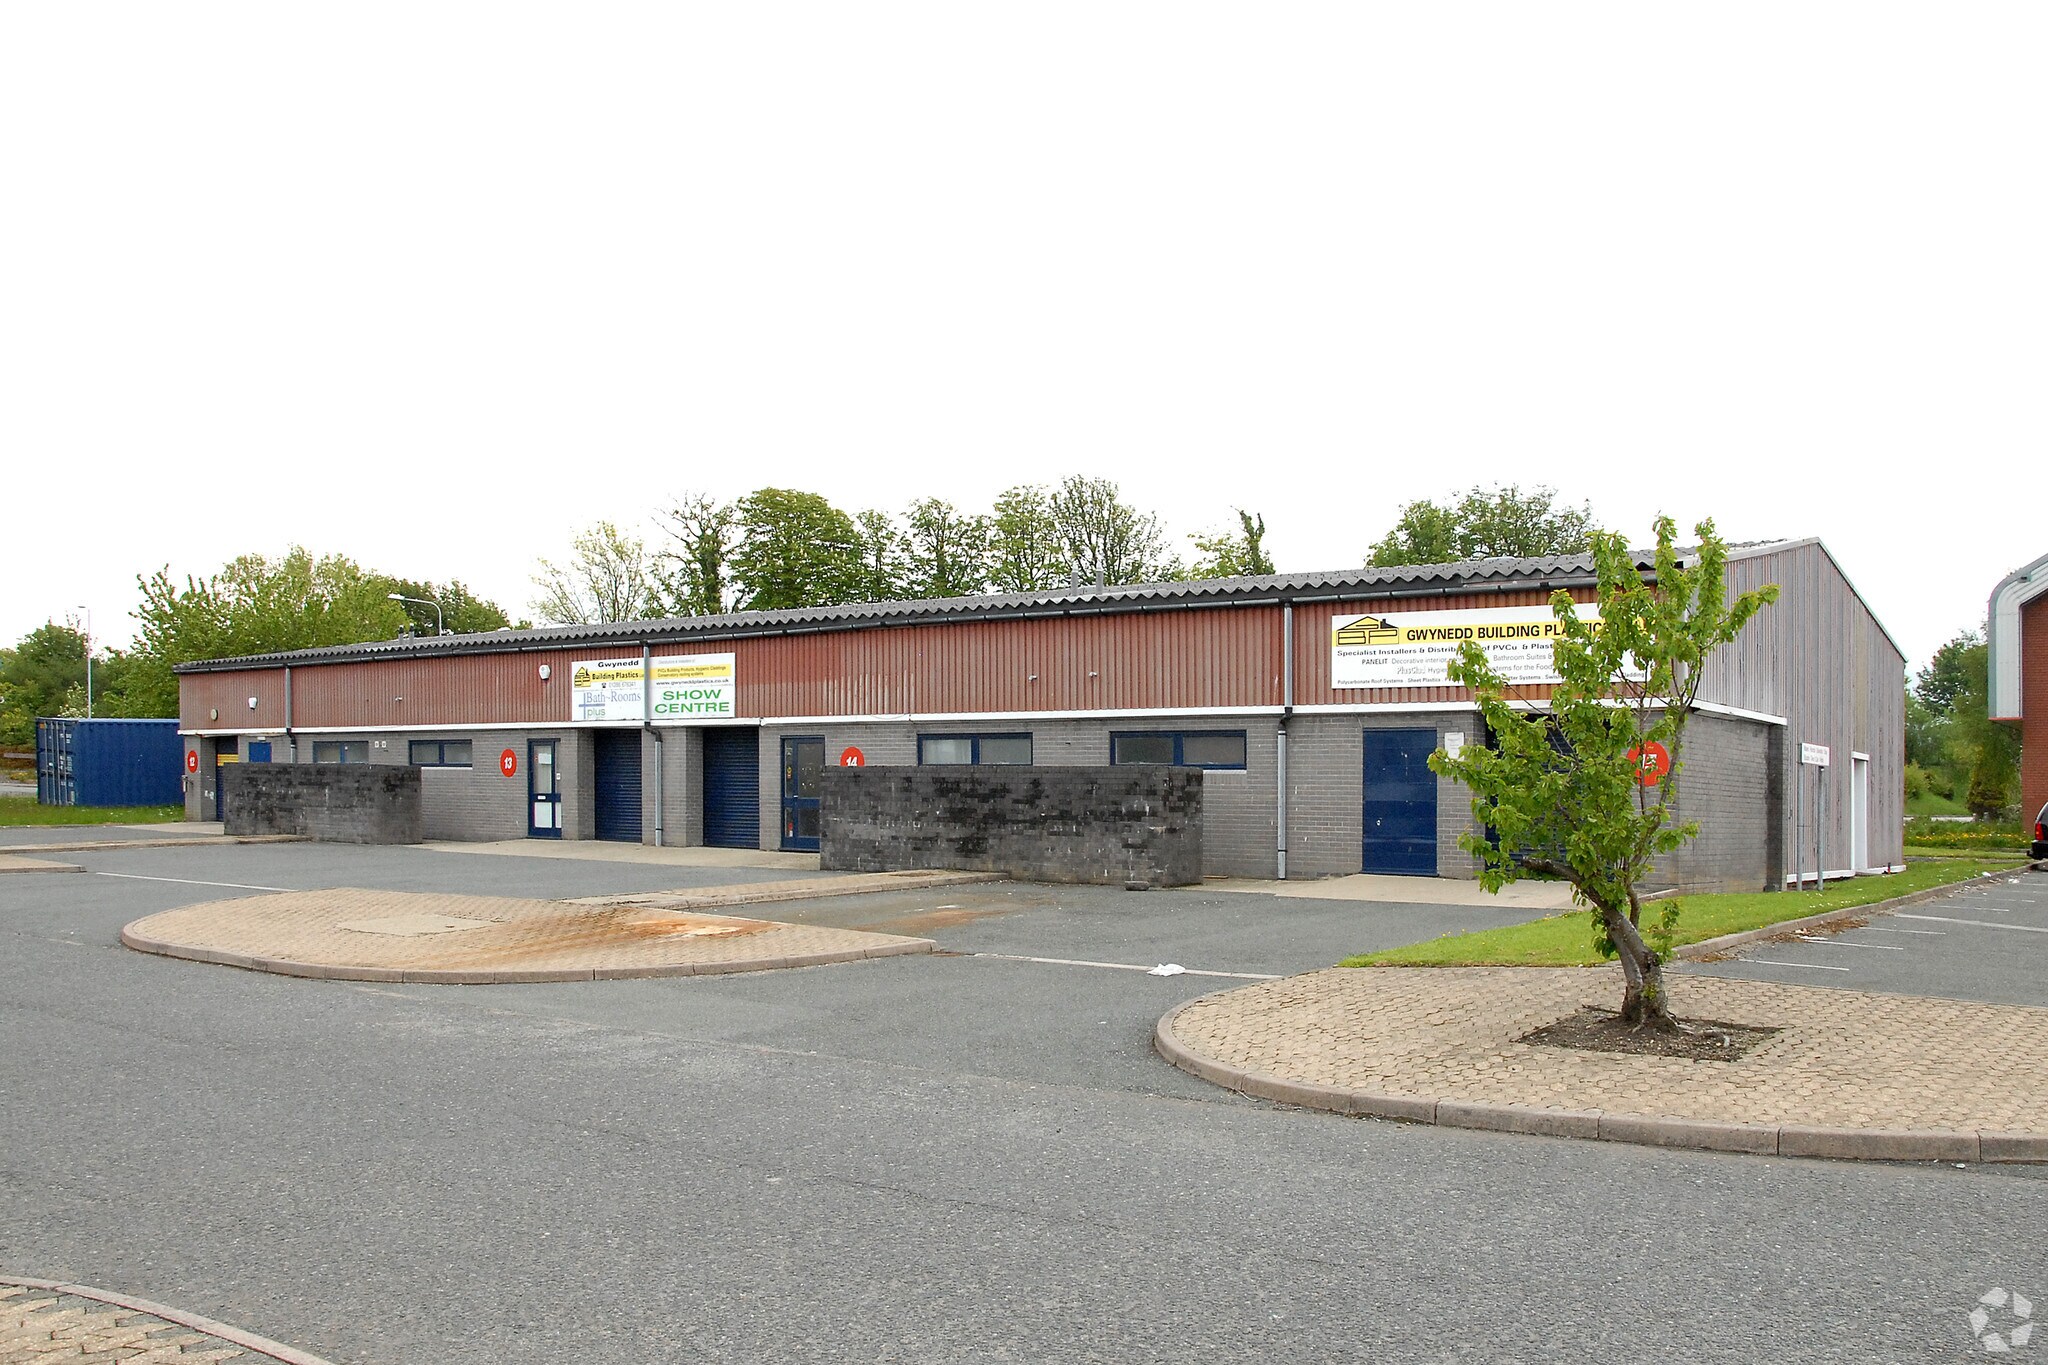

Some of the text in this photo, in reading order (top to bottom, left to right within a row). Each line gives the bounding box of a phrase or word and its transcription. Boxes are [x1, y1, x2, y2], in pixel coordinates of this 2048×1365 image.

[1407, 627, 1473, 640] GWYNEDD
[1478, 625, 1540, 638] BUILDING
[1493, 654, 1525, 662] Bathroom
[598, 660, 639, 668] Gwynedd
[615, 671, 639, 679] Plastics
[663, 689, 722, 700] SHOW
[587, 708, 606, 716] plus
[655, 702, 730, 713] CENTRE
[504, 757, 513, 769] 13
[846, 756, 858, 766] 14
